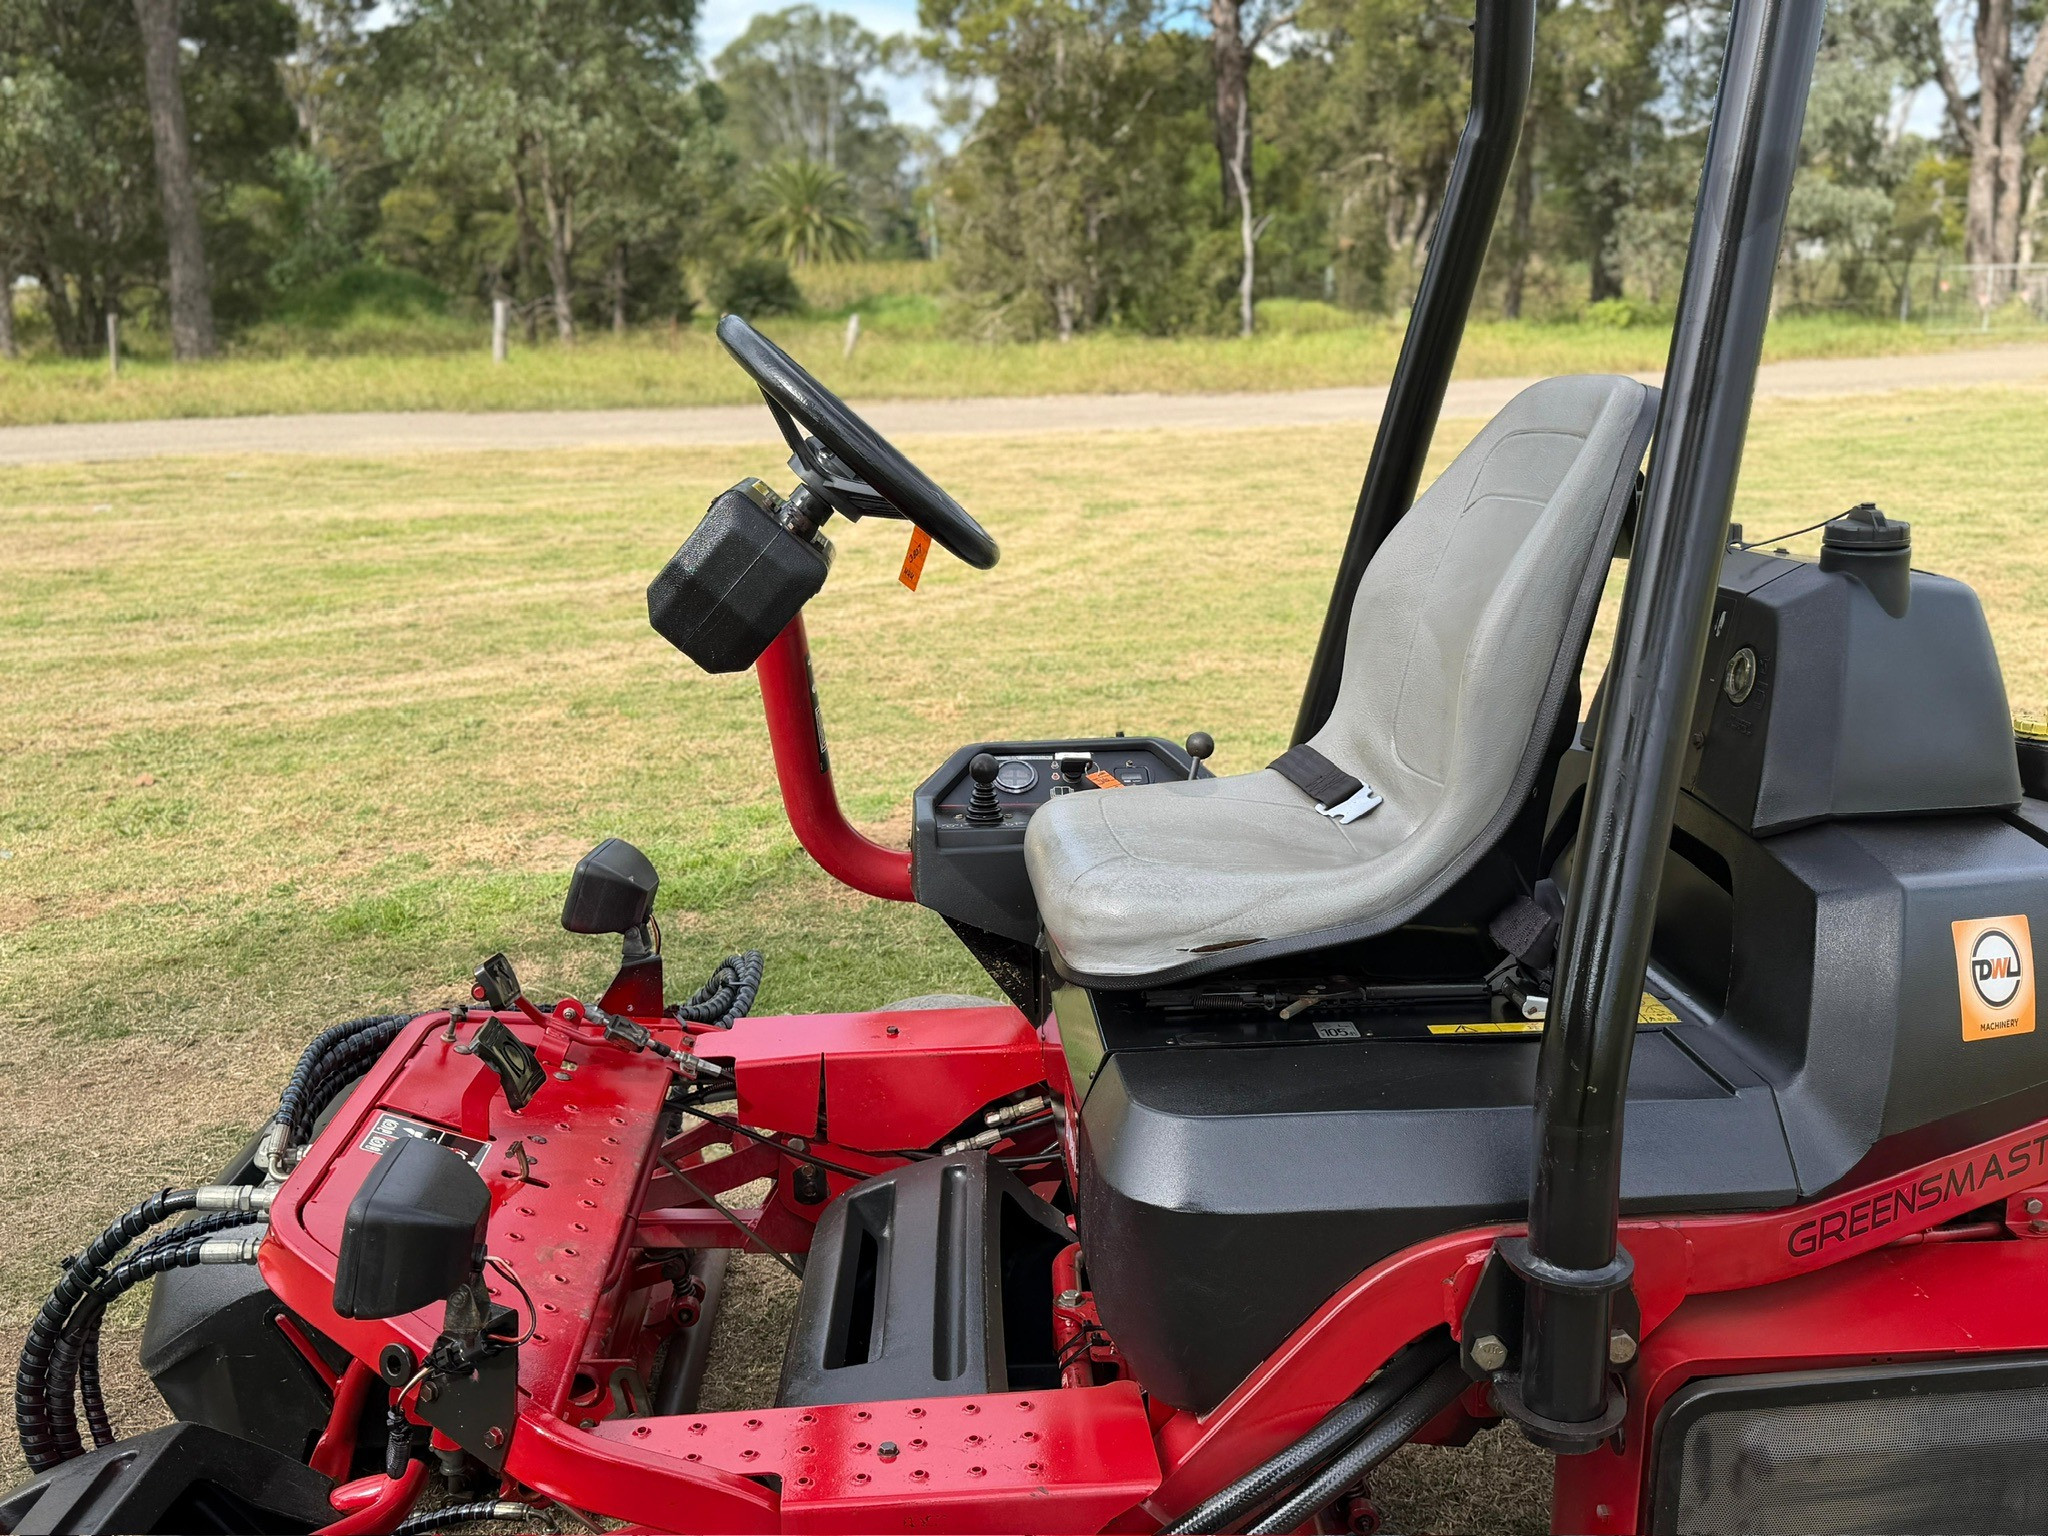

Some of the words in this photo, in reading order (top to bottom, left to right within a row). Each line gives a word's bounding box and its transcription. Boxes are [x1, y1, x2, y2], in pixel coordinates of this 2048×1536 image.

[1972, 957, 2021, 981] DWL
[1980, 1018, 2019, 1031] MACHINERY
[1320, 1027, 1349, 1037] 105
